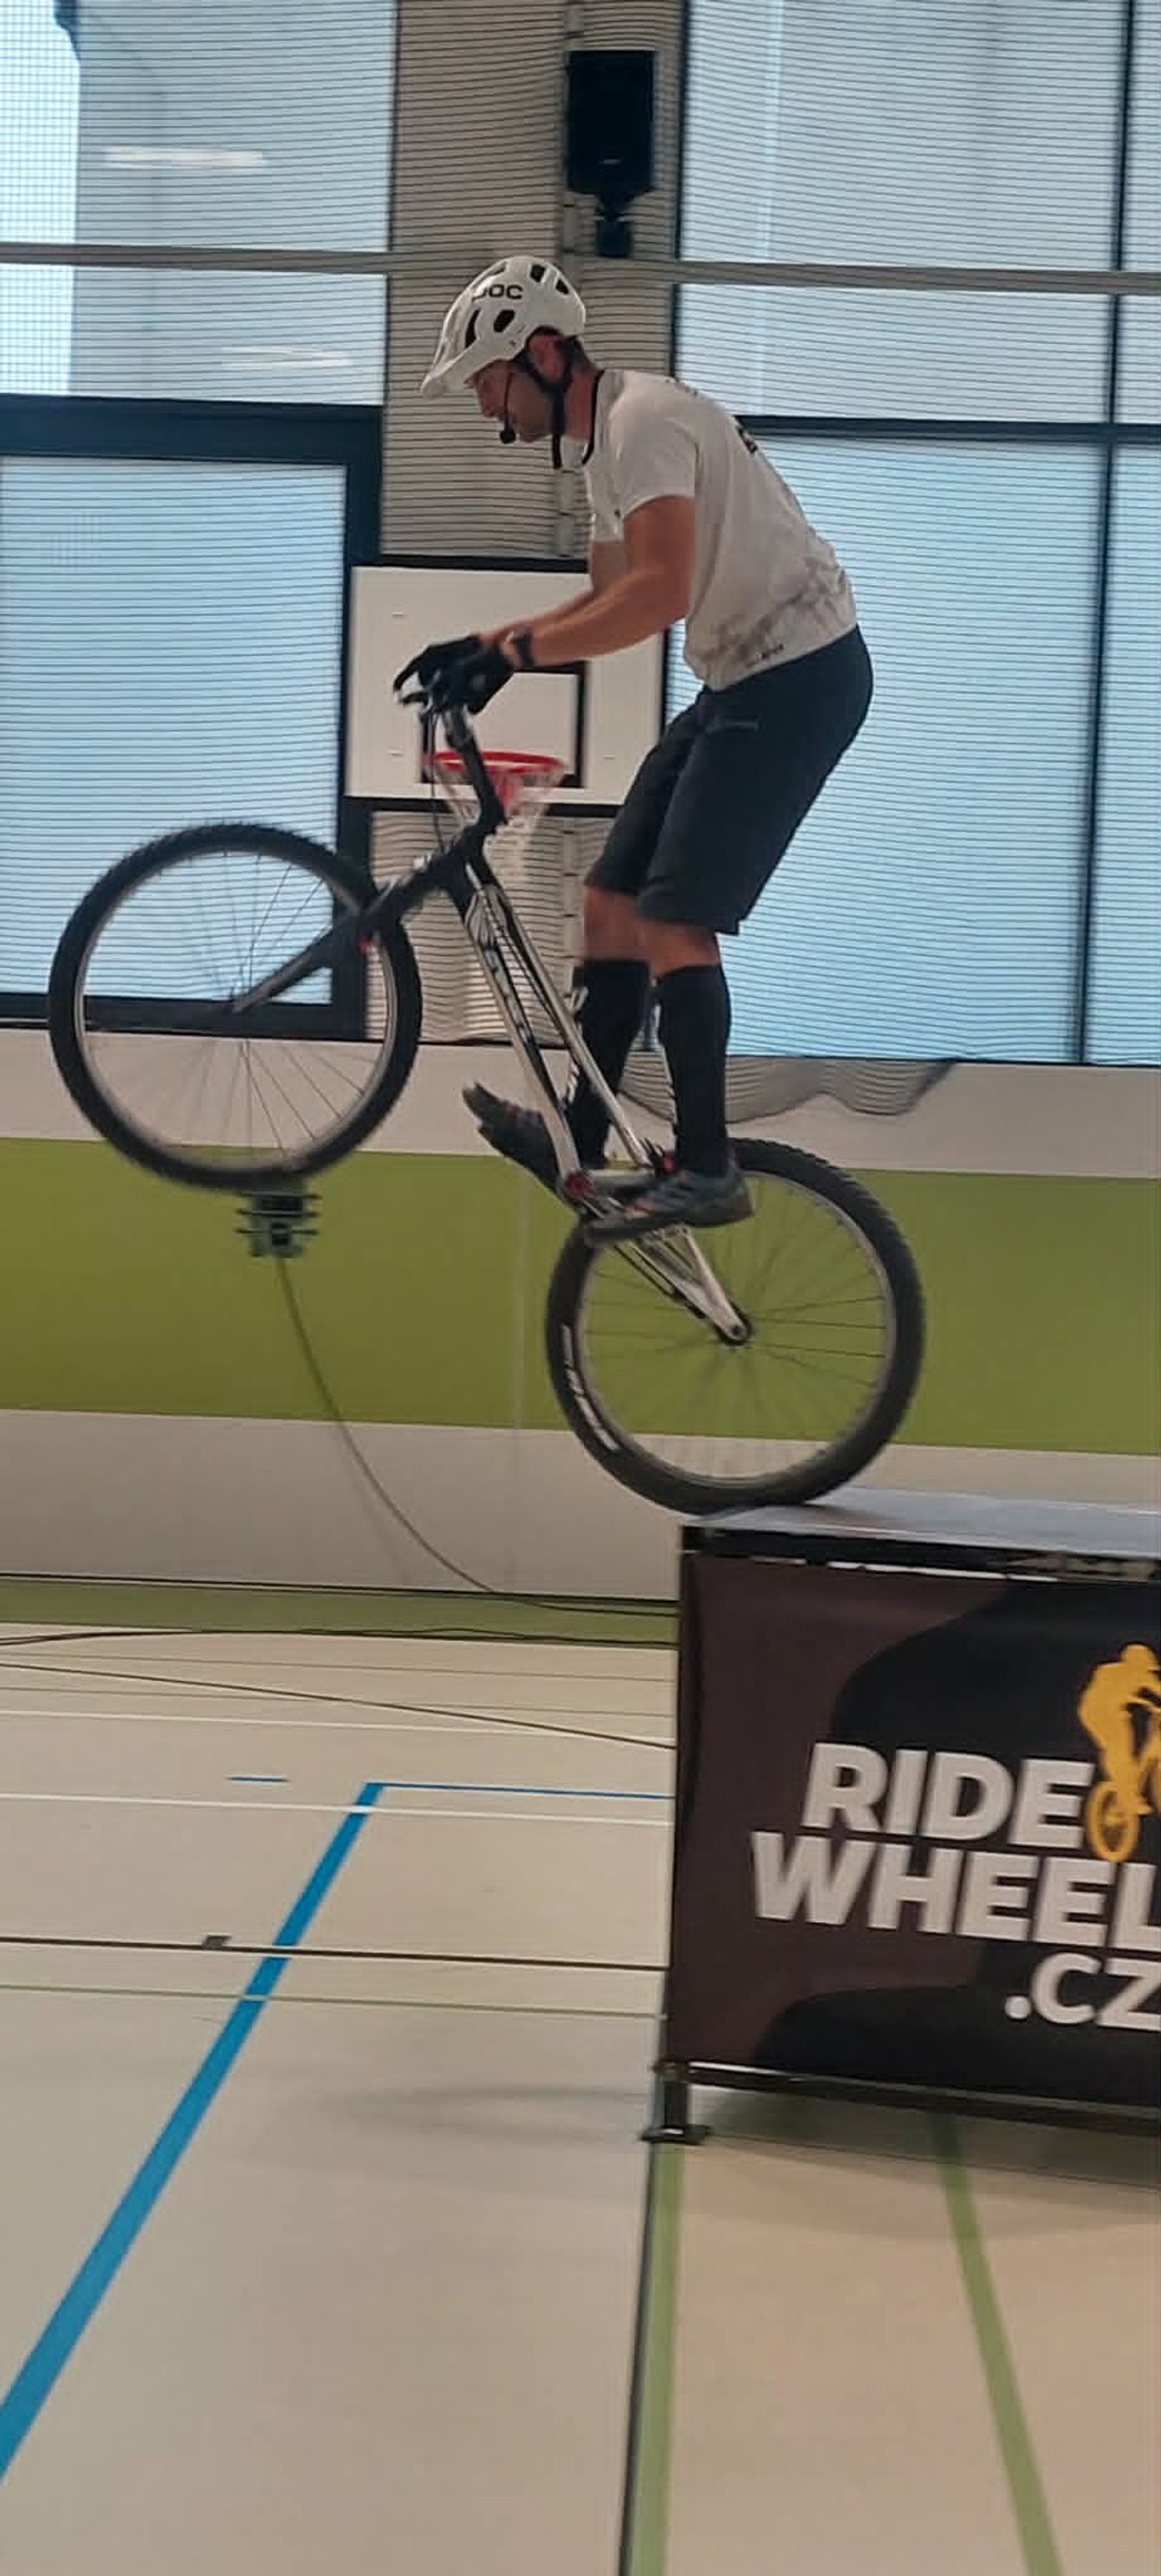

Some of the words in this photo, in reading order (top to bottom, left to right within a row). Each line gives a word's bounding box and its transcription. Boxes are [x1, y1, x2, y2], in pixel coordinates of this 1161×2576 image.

[802, 1742, 1095, 1849] RIDE
[751, 1830, 1161, 1952] WHEEL
[1005, 1952, 1161, 2033] .CZ
